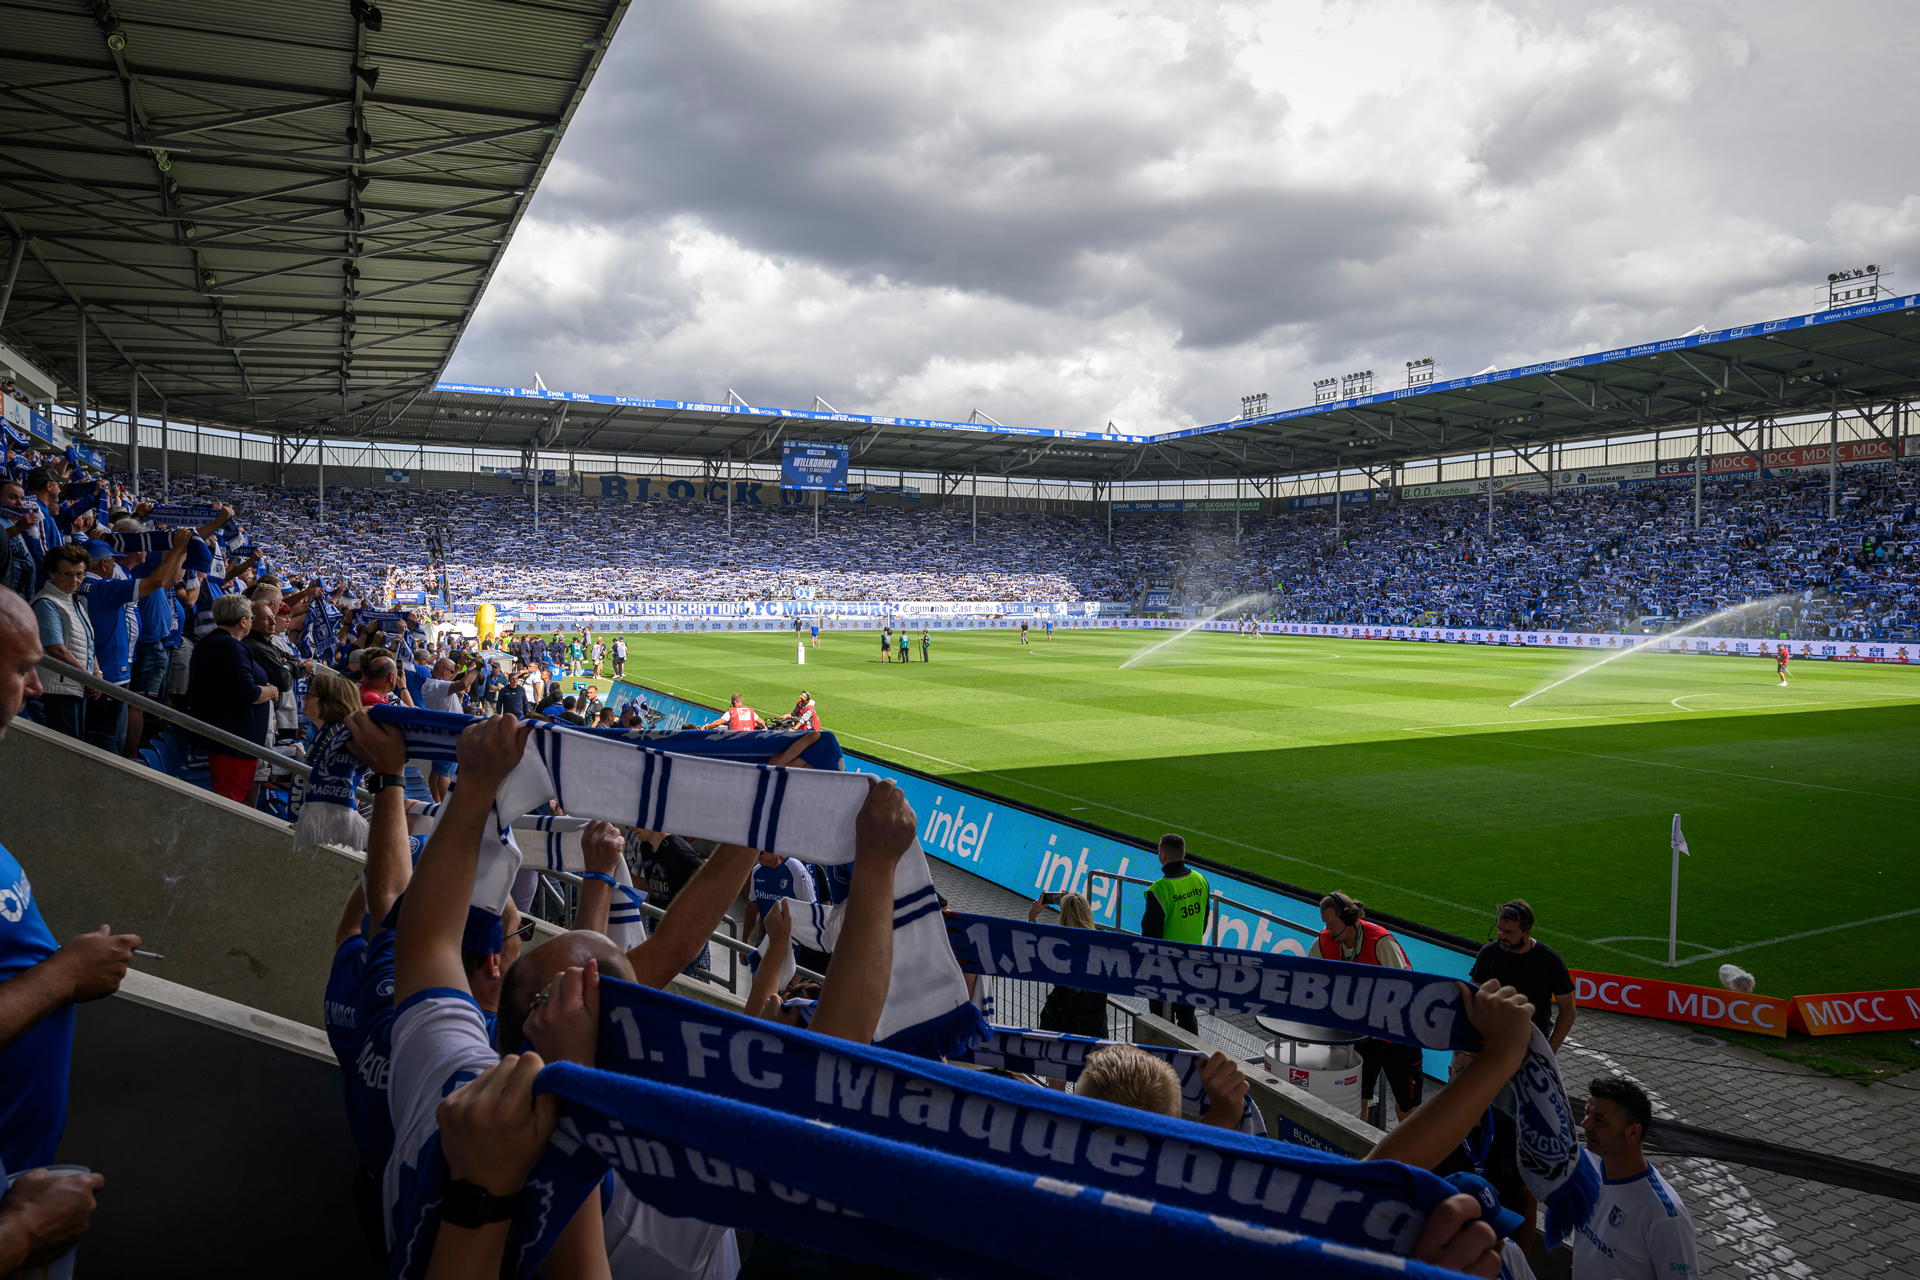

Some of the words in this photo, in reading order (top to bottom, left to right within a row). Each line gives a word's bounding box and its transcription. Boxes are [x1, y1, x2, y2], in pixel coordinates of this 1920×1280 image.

[1824, 302, 1895, 321] www.kk-office.com
[1630, 344, 1656, 353] mhkw
[1659, 339, 1686, 348] mhkw
[1602, 349, 1627, 358] mhkw
[1520, 365, 1545, 375] Rasch
[1545, 358, 1584, 371] Reinigung
[521, 388, 539, 396] SWM
[547, 390, 565, 398] SWM
[572, 392, 590, 400] SWM
[1393, 388, 1415, 399] FEGERT
[1332, 401, 1349, 410] ÖHMI
[1356, 396, 1373, 405] ÖHMI
[36, 417, 48, 436] GETEC
[1803, 446, 1846, 461] MDCC
[1853, 441, 1900, 455] MDC
[793, 457, 838, 469] WILLKOMMEN
[1660, 463, 1679, 474] ets
[1687, 461, 1708, 472] es
[1712, 456, 1750, 469] MDCC
[1588, 475, 1625, 483] ENGELMANN
[1670, 476, 1713, 486] SORGOS
[599, 475, 763, 505] BLOCK
[1403, 487, 1470, 499] B.O.D.-Hochbau
[457, 603, 499, 614] 195
[595, 602, 636, 615] BLUE
[645, 603, 741, 615] GENERATION
[782, 602, 893, 616] MAGDEBURG
[902, 604, 949, 613] Commndo
[951, 603, 972, 613] East
[974, 603, 994, 613] Side
[923, 796, 993, 863] intel
[1034, 834, 1130, 918] intel
[1172, 886, 1203, 903] Security
[1180, 901, 1201, 919] 369
[1132, 941, 1264, 968] TREUE
[965, 922, 1072, 976] 1.FC
[1086, 945, 1463, 1051] MAGDEBURG
[1133, 984, 1269, 1017] STOLZ
[1667, 989, 1775, 1029] MDCC
[1805, 997, 1894, 1027] MDCC
[610, 1006, 664, 1064] 1.
[680, 1021, 785, 1090] FC
[1345, 1076, 1357, 1085] sport
[1293, 1127, 1322, 1151] BLOCK
